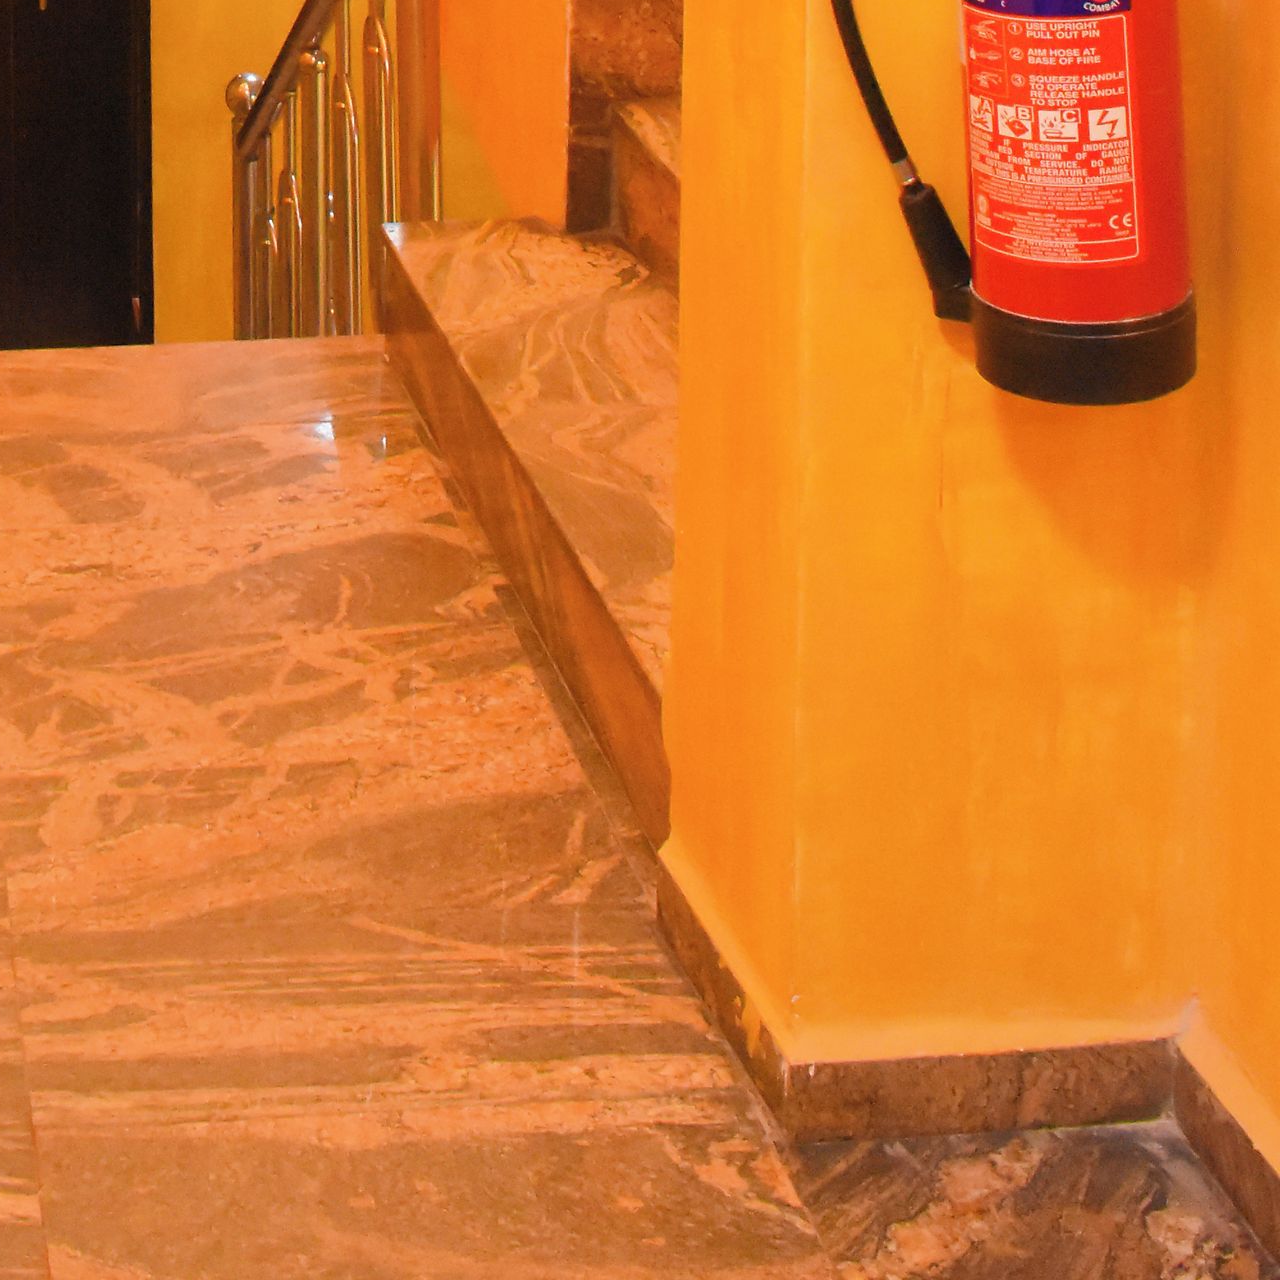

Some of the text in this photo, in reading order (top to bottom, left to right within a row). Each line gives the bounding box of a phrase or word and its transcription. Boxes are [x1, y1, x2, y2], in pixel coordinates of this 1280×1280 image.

[1026, 22, 1048, 30] USE
[1050, 21, 1098, 31] UPRIGHT
[1026, 30, 1100, 39] PULL OUT PIN
[1027, 48, 1048, 56] AIM
[1049, 48, 1080, 57] HOSE
[1082, 48, 1096, 56] AT
[1028, 55, 1101, 65] BASE OF FIRE
[1028, 74, 1080, 84] SQUEEZE
[1082, 70, 1125, 83] HANDLE
[1030, 86, 1125, 99] RELEASE HANDLE
[1047, 82, 1098, 92] OPERATE
[982, 100, 992, 114] A
[1030, 98, 1078, 107] TO STOP
[1017, 106, 1031, 120] B
[1062, 110, 1077, 122] C
[1022, 142, 1068, 152] PRESSURE
[1082, 140, 1129, 152] INDICATOR
[1024, 150, 1062, 160] SECTION
[1075, 152, 1087, 160] OF
[1101, 148, 1129, 159] GAUGE
[1008, 155, 1031, 166] FROM
[1090, 160, 1104, 168] DO
[1113, 156, 1129, 165] NOT
[1024, 166, 1088, 177] TEMPERATURE
